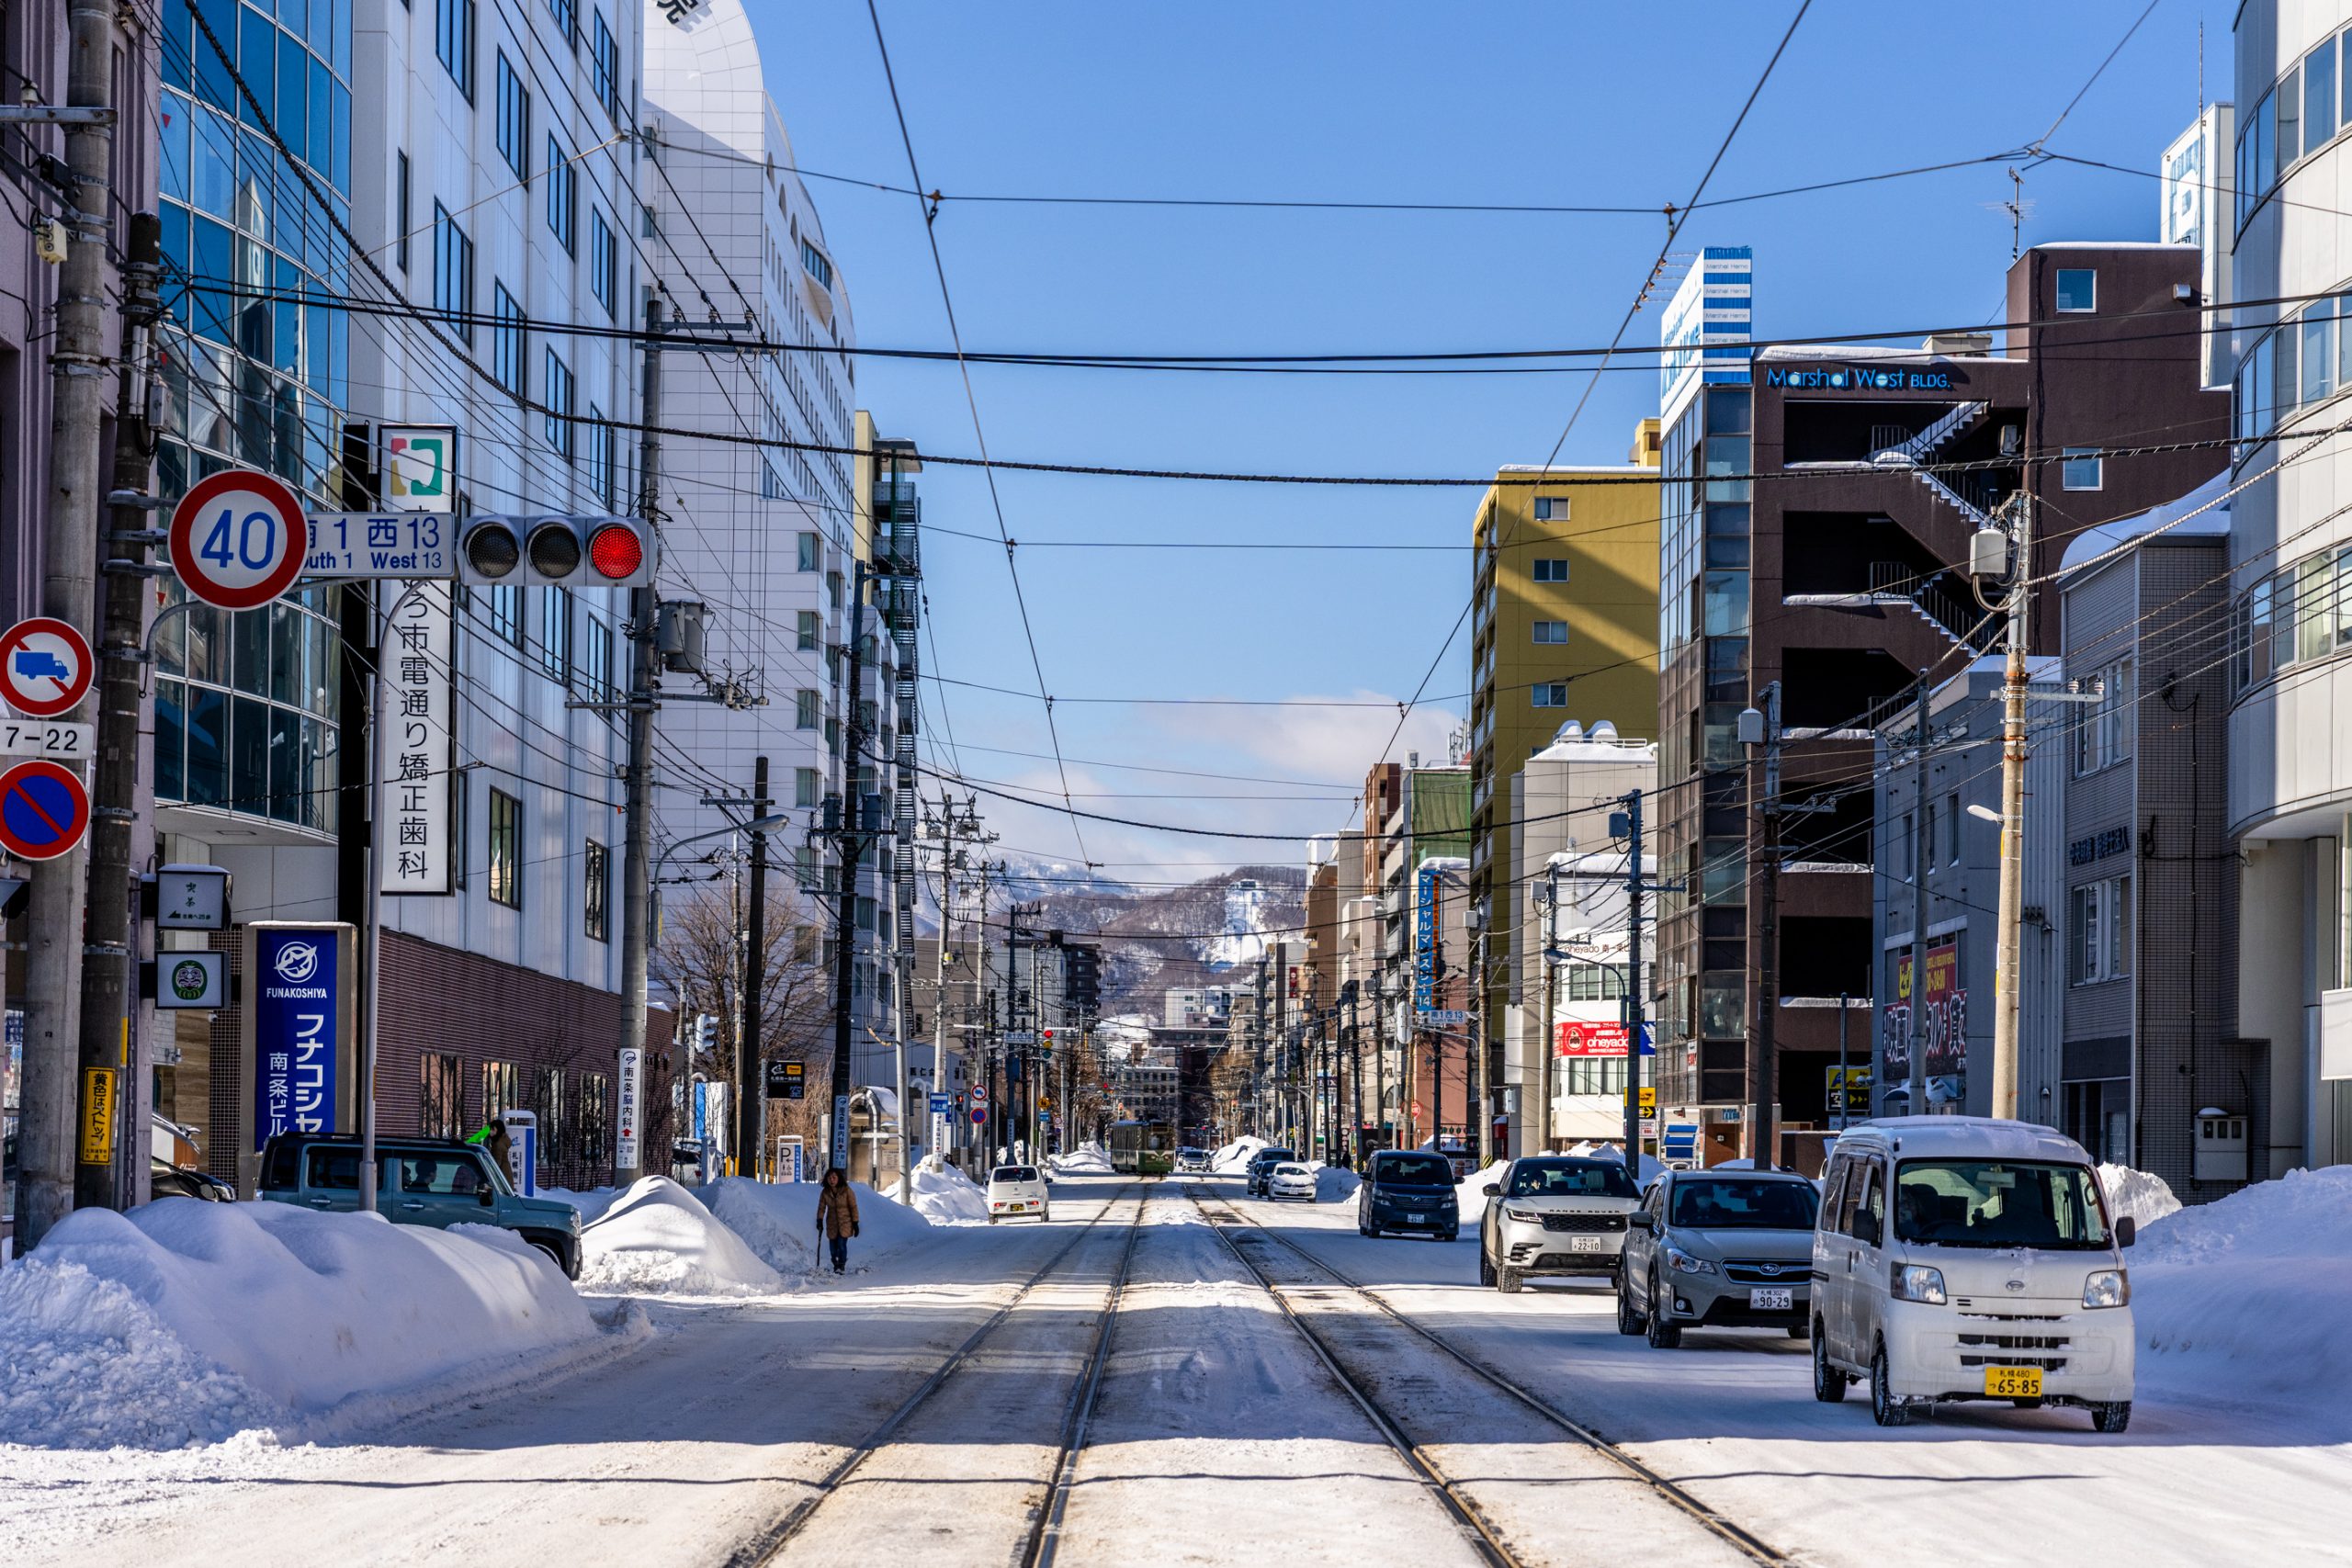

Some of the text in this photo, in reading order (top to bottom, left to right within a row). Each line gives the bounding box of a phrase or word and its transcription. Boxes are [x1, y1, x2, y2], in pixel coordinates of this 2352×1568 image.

[1767, 368, 1951, 388] Marshal West BLDG.
[200, 509, 276, 570] 40
[334, 518, 346, 549] 1
[368, 519, 398, 547] 西
[407, 517, 439, 549] 13
[344, 552, 352, 569] 1
[371, 552, 417, 569] West
[423, 552, 441, 569] 13
[186, 882, 197, 907] 喫茶
[266, 987, 327, 998] FUNAKOSHIYA
[269, 1052, 288, 1137] 南一条ビル
[623, 1067, 634, 1128] 南一条脳内科
[780, 1148, 791, 1162] P
[1760, 1297, 1789, 1308] 90-29
[2016, 1370, 2030, 1378] 480
[1998, 1379, 2040, 1394] 65-85
